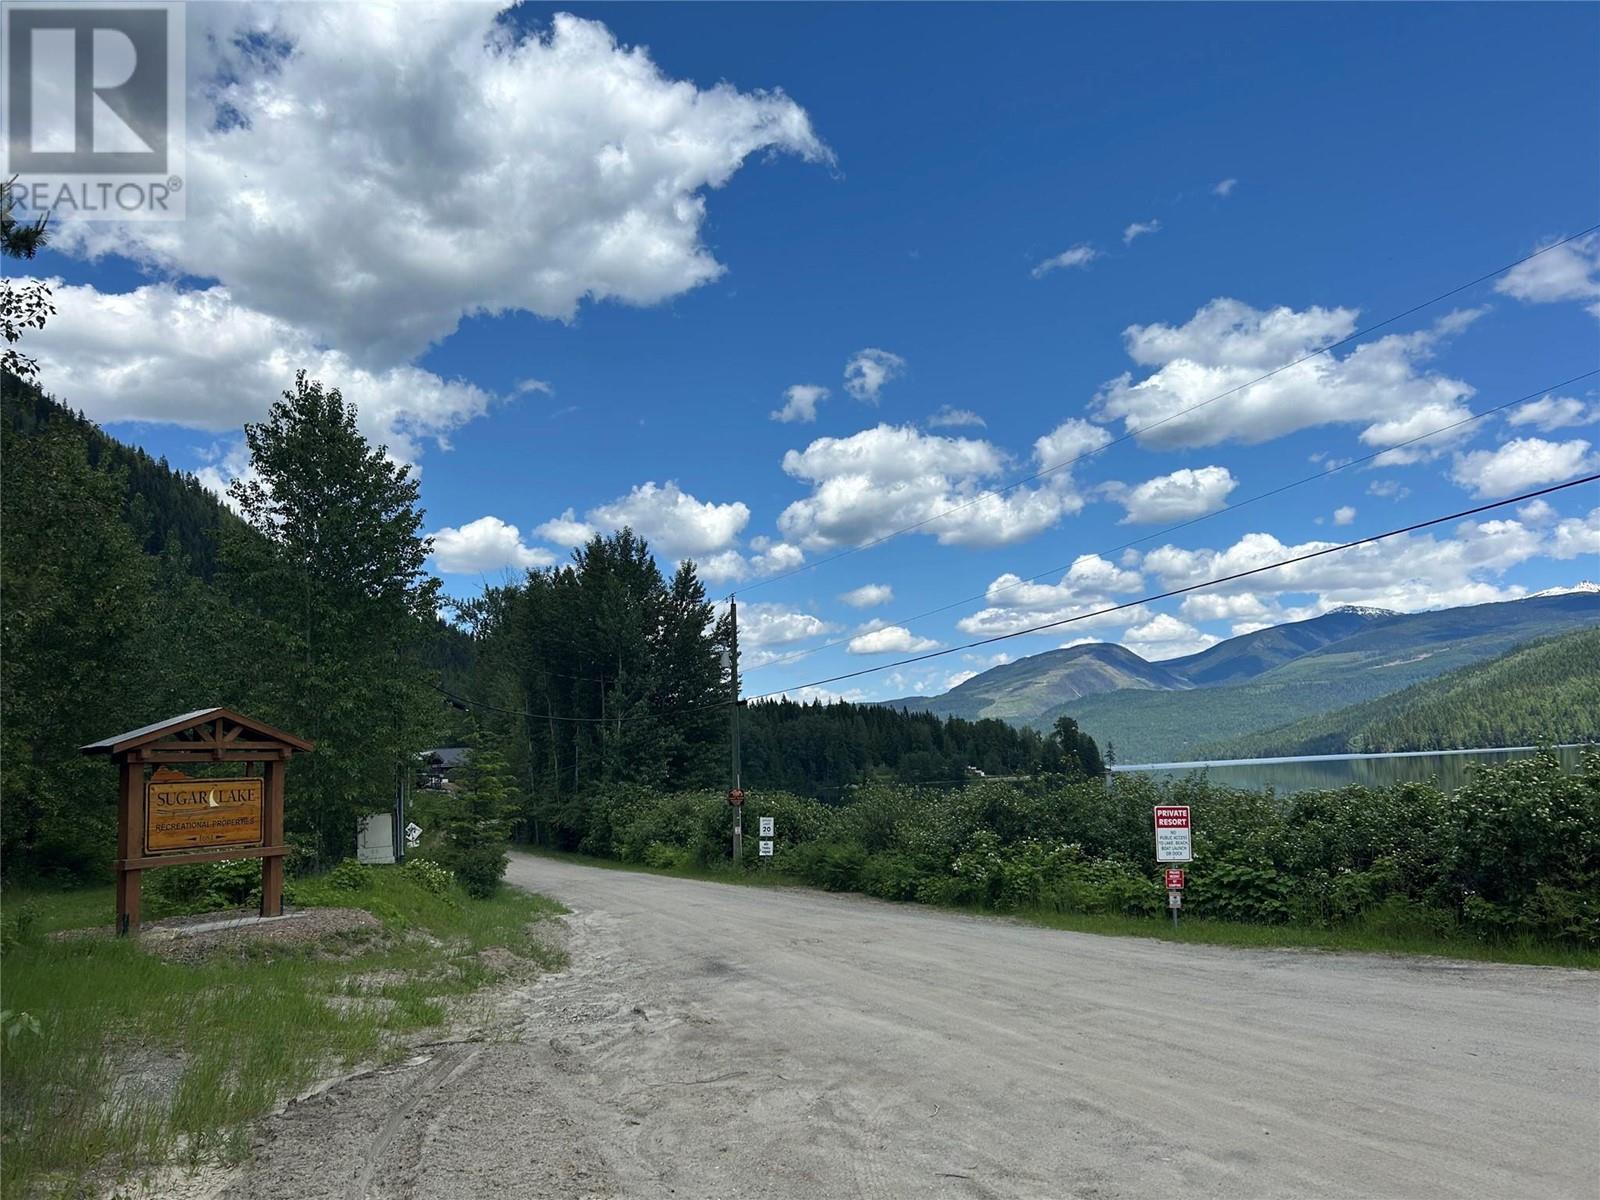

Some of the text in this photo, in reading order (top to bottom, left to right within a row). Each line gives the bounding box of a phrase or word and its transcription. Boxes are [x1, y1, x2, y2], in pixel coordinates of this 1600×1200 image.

[157, 788, 256, 806] SUGAR LAKE
[156, 816, 256, 832] RECREATIONAL PROPERTIES
